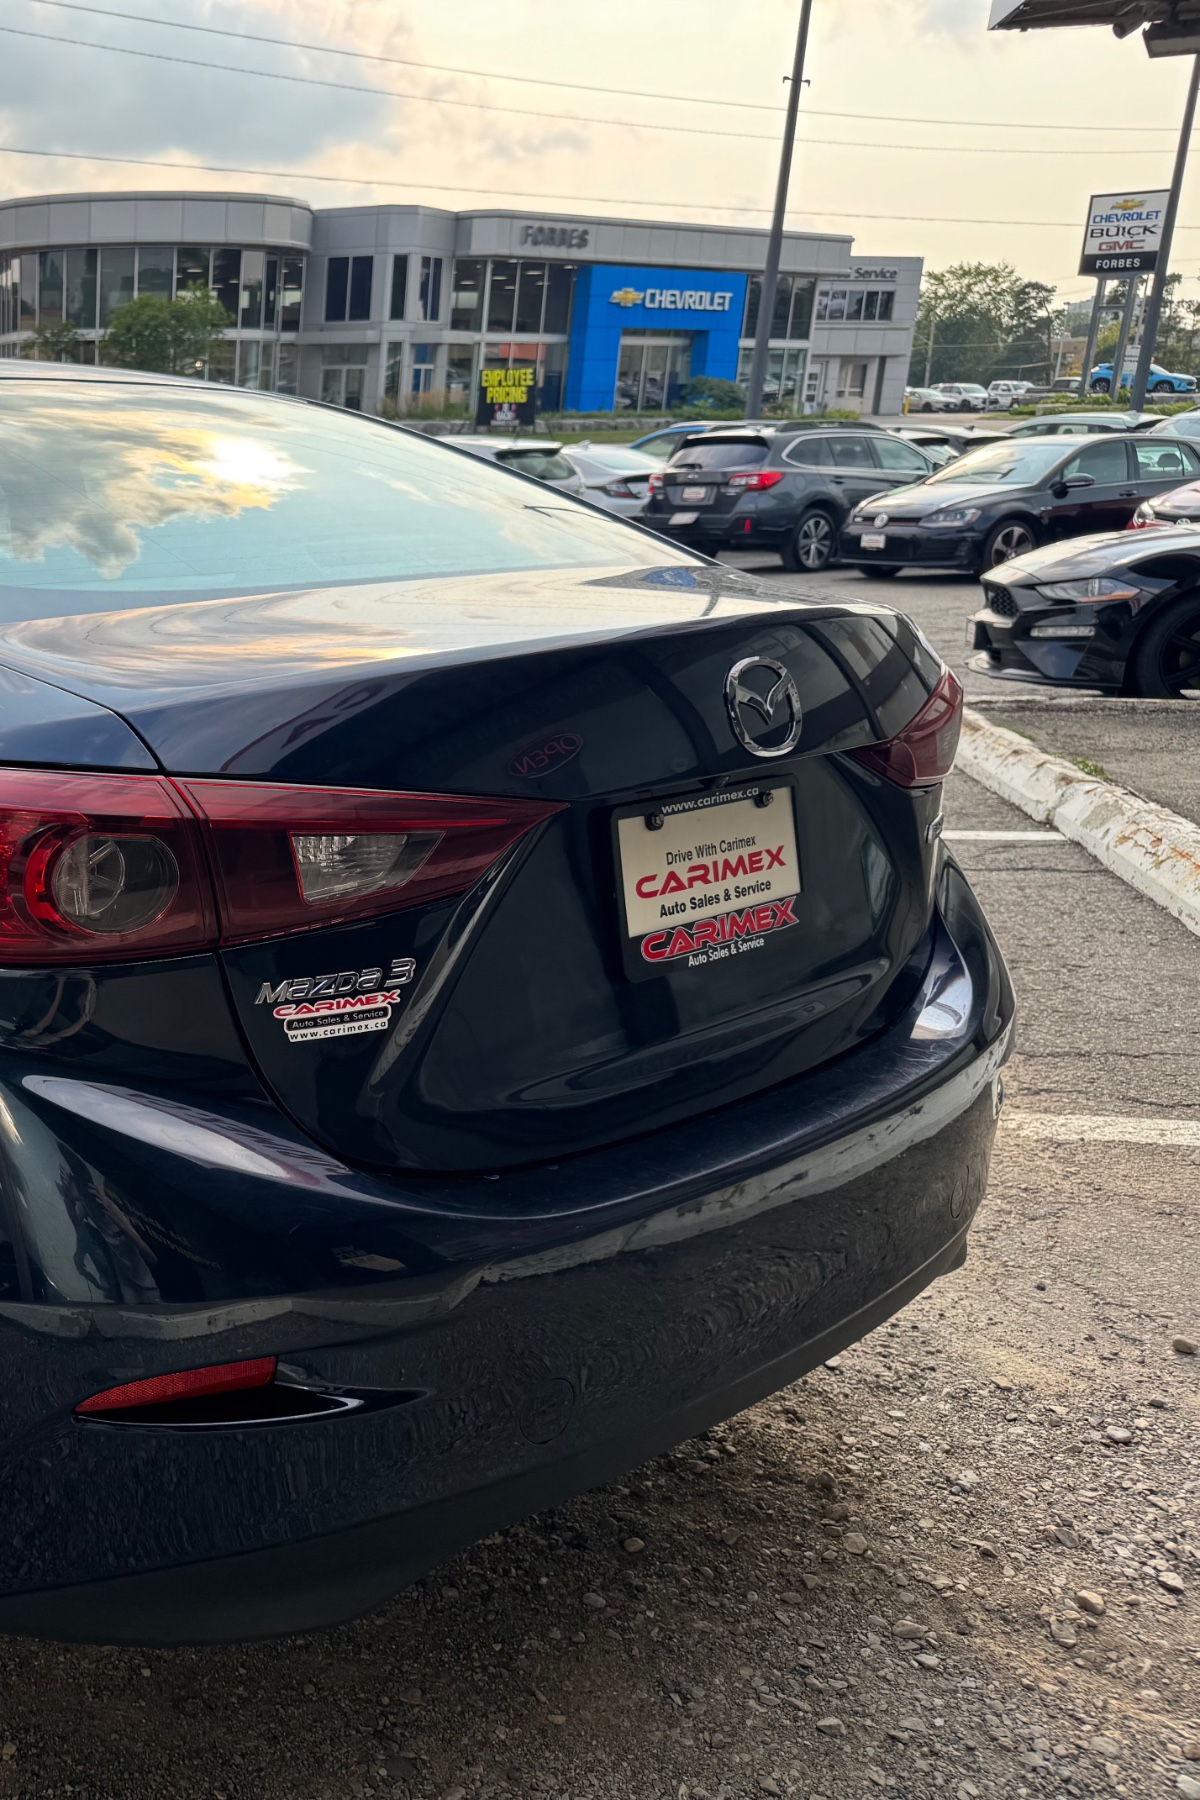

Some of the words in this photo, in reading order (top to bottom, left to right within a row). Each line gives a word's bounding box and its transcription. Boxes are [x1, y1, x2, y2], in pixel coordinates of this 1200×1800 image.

[1093, 210, 1161, 224] CHEVROLET
[521, 226, 589, 249] FORBES
[1090, 224, 1159, 238] BUICK
[1098, 239, 1146, 251] GMC
[854, 267, 898, 279] Service
[1095, 258, 1141, 269] FORBES
[644, 289, 733, 311] CHEVROLET
[481, 368, 535, 387] EMPLOYEE
[486, 386, 528, 404] PRICING
[661, 787, 760, 815] www.carimex.ca
[666, 850, 693, 866] Drive
[695, 842, 718, 858] With
[719, 835, 757, 854] Carimex
[635, 845, 787, 899] CARIMEX
[659, 900, 687, 919] Auto
[690, 892, 721, 910] Sales
[723, 888, 732, 902] &
[734, 879, 772, 899] Service
[642, 896, 799, 962] CARIMEX
[688, 953, 707, 967] Auto
[708, 945, 730, 960] Sales
[730, 942, 737, 954] &
[738, 937, 765, 953] Service
[384, 957, 417, 988] 3
[274, 990, 400, 1017] CARIMEX
[290, 1020, 387, 1041] www.carimex.ca
[292, 1019, 314, 1030] Auto
[317, 1015, 341, 1025] Sales
[343, 1014, 350, 1022] &
[352, 1009, 384, 1021] Service
